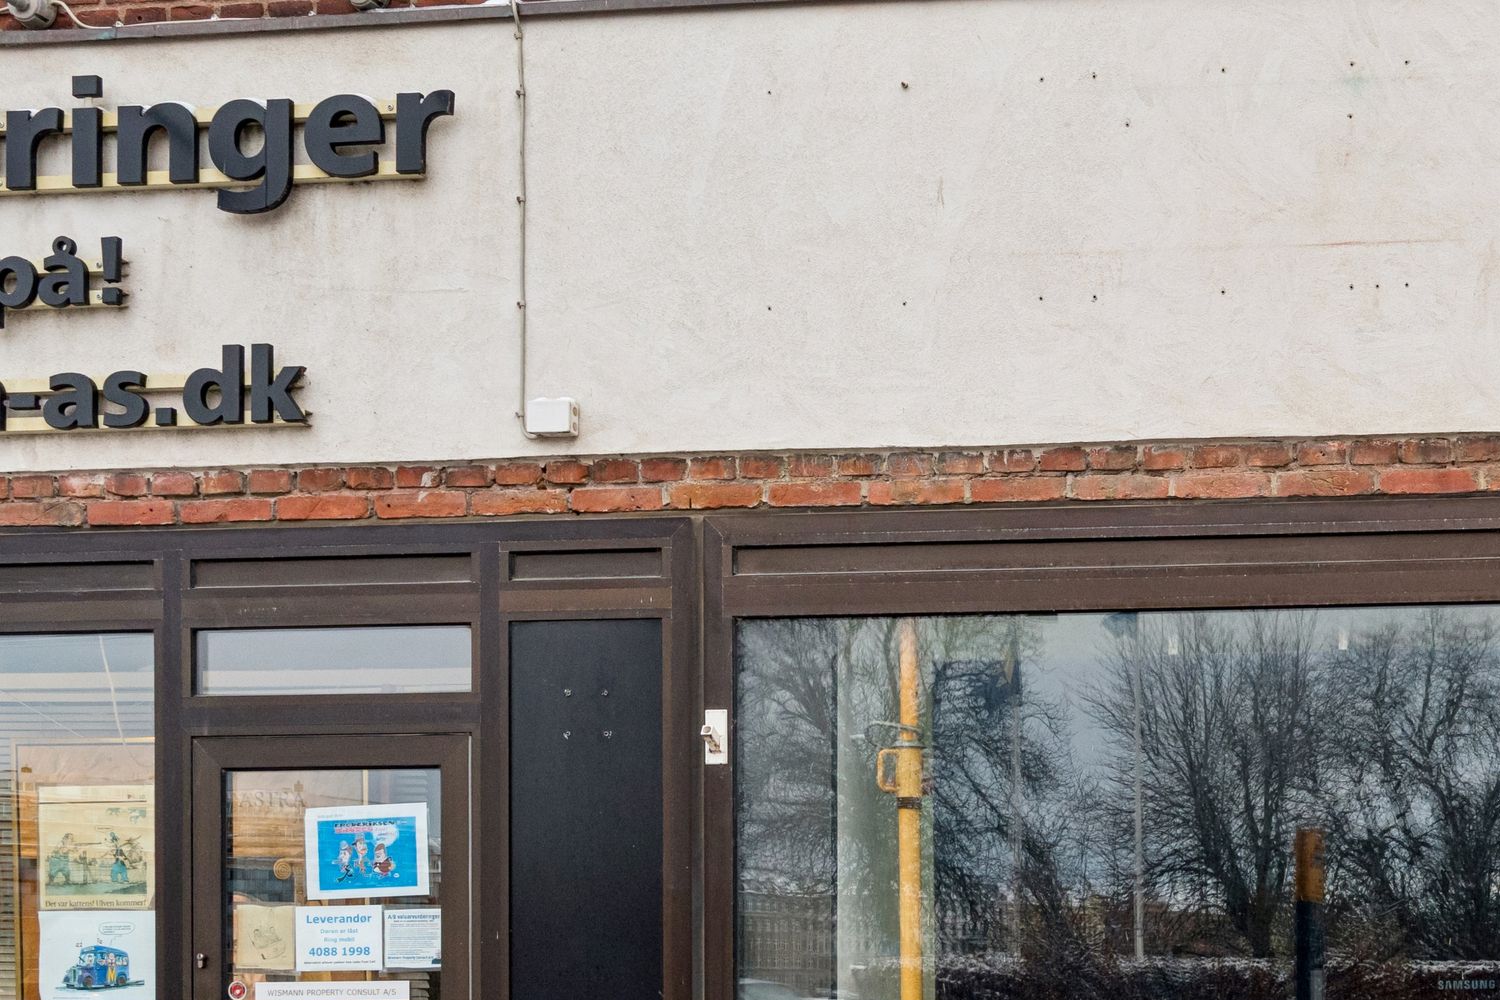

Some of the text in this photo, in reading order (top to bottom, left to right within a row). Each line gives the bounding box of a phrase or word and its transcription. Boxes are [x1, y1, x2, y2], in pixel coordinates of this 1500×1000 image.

[5, 74, 456, 214] ringer
[0, 343, 308, 431] -as.dk
[306, 914, 372, 924] Leverandør
[308, 946, 370, 957] 4088 1998
[1438, 979, 1496, 990] SAMSUNG
[267, 988, 397, 997] WISMANN PROPERTY CONSULT A/S
